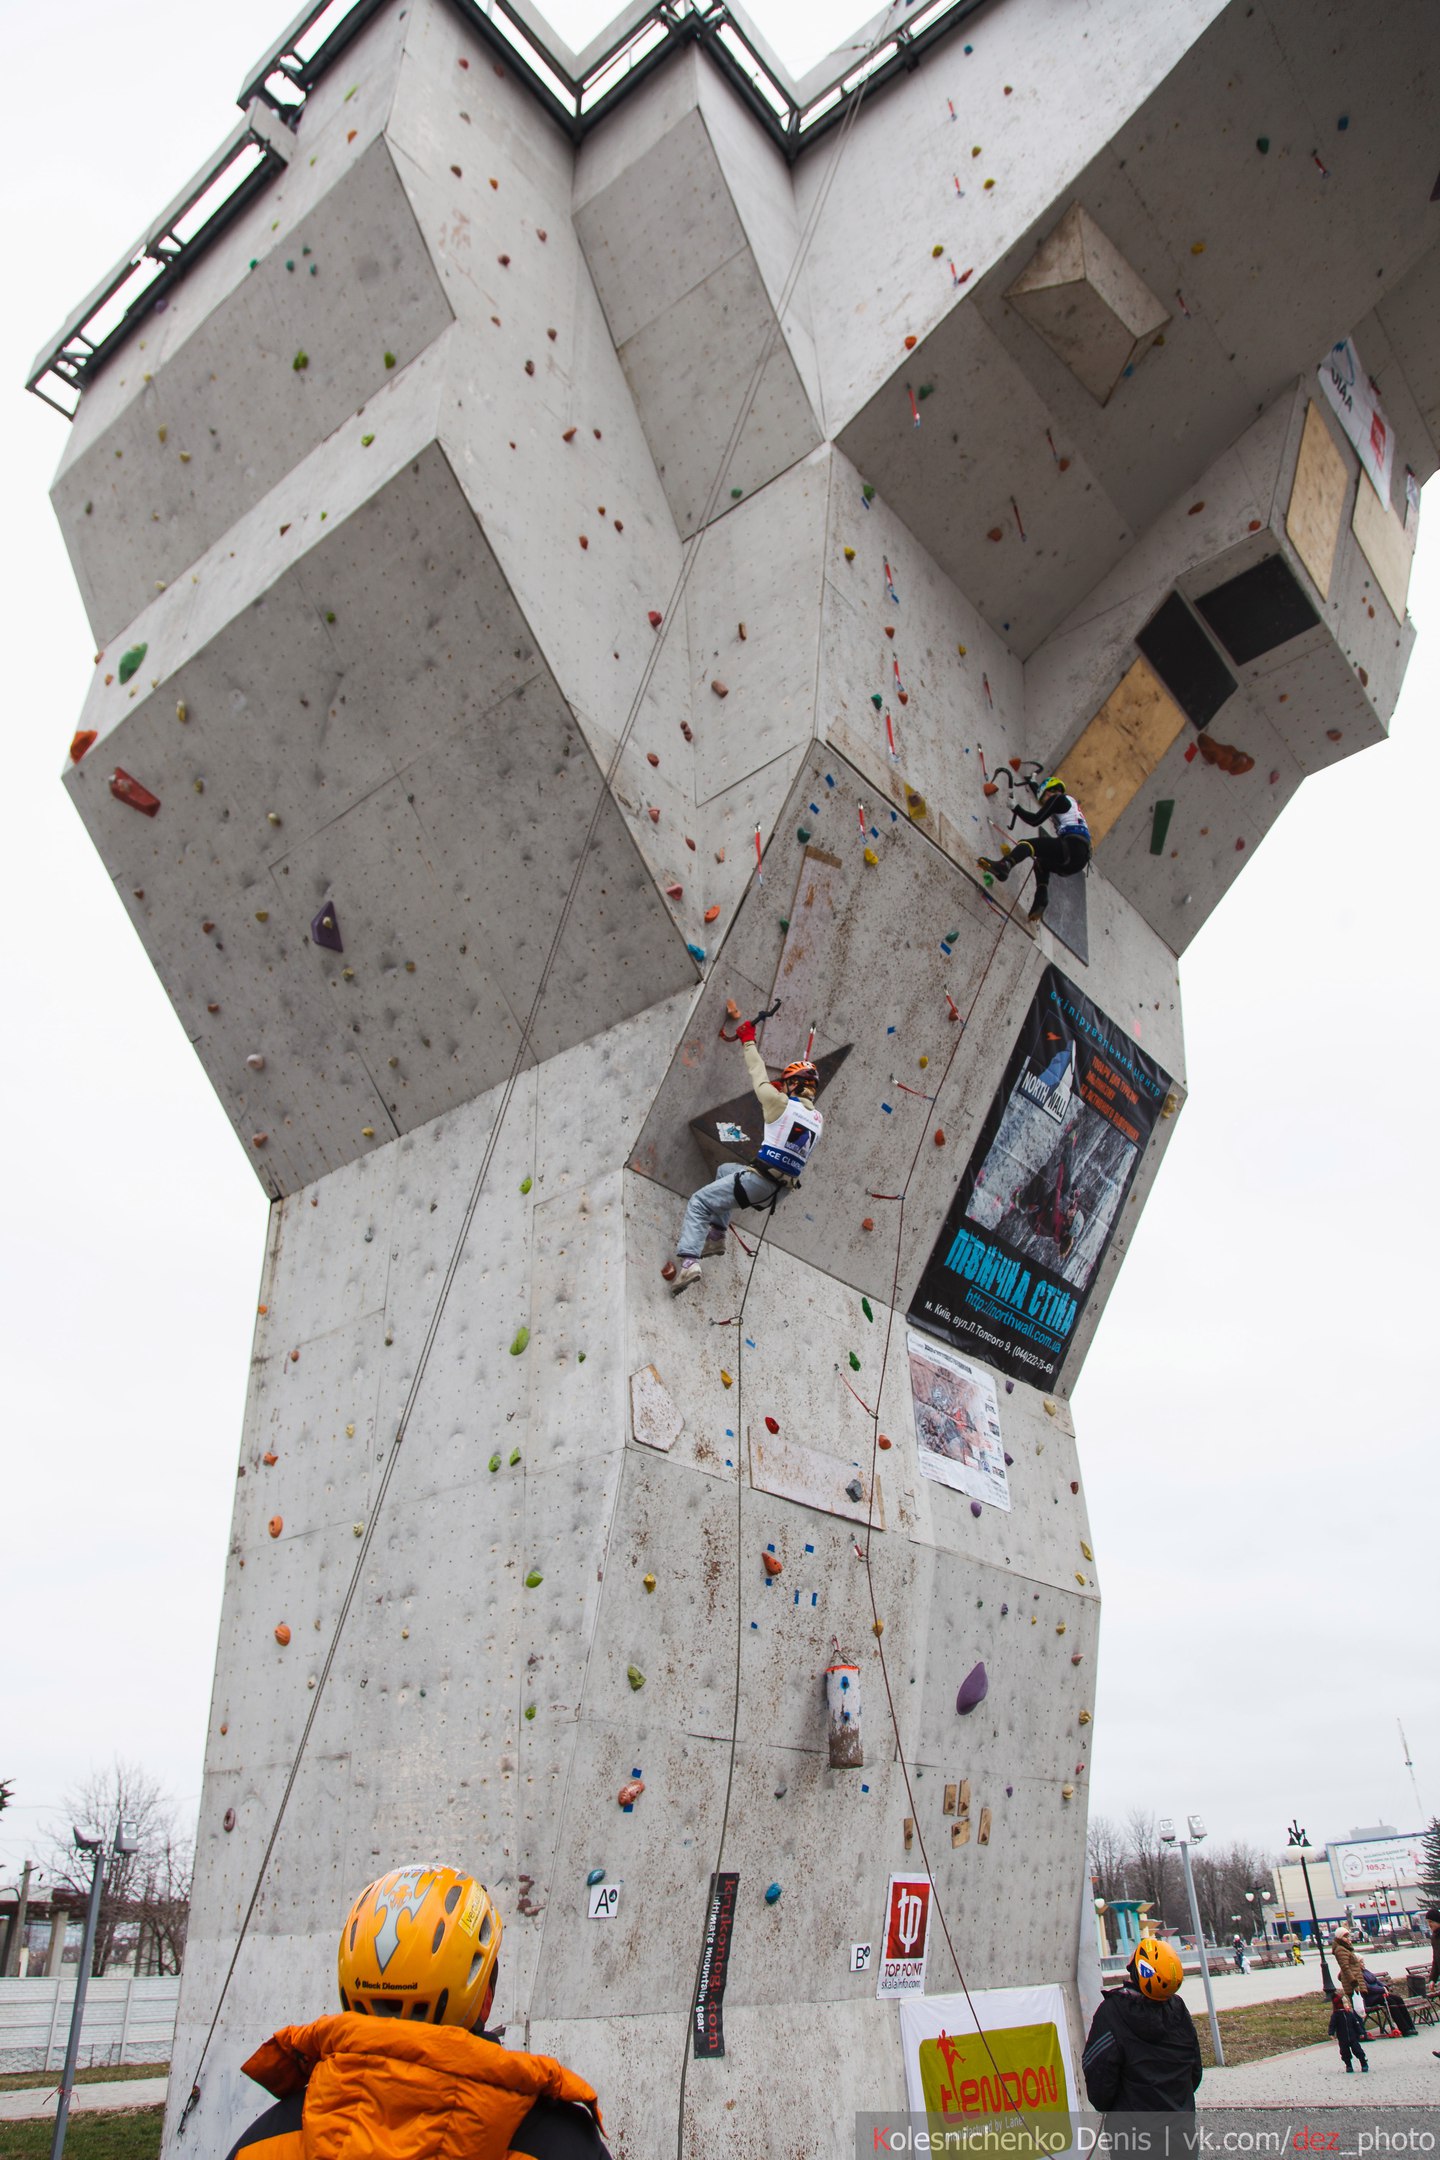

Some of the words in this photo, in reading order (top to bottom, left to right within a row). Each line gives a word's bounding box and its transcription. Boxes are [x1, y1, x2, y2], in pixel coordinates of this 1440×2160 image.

[1022, 1071, 1050, 1104] NORTH
[1047, 1092, 1066, 1118] WALL
[1133, 1068, 1161, 1097] центр
[766, 1149, 782, 1160] ICE
[944, 1228, 1031, 1309] ПІВНІЧНА
[1028, 1280, 1078, 1336] СТІНА
[934, 1304, 951, 1321] Київ,
[965, 1288, 1062, 1354] http://northwall.com.ua
[594, 1888, 609, 1914] A
[706, 1896, 720, 1944] ultimate
[708, 1879, 736, 2049] krukonogi.com
[856, 1947, 866, 1969] B
[885, 1964, 900, 1977] TOP
[902, 1963, 923, 1977] POINT
[362, 1981, 380, 1989] Black
[382, 1982, 418, 1990] Diamond
[698, 1946, 714, 2002] mountain
[695, 2006, 705, 2033] gear
